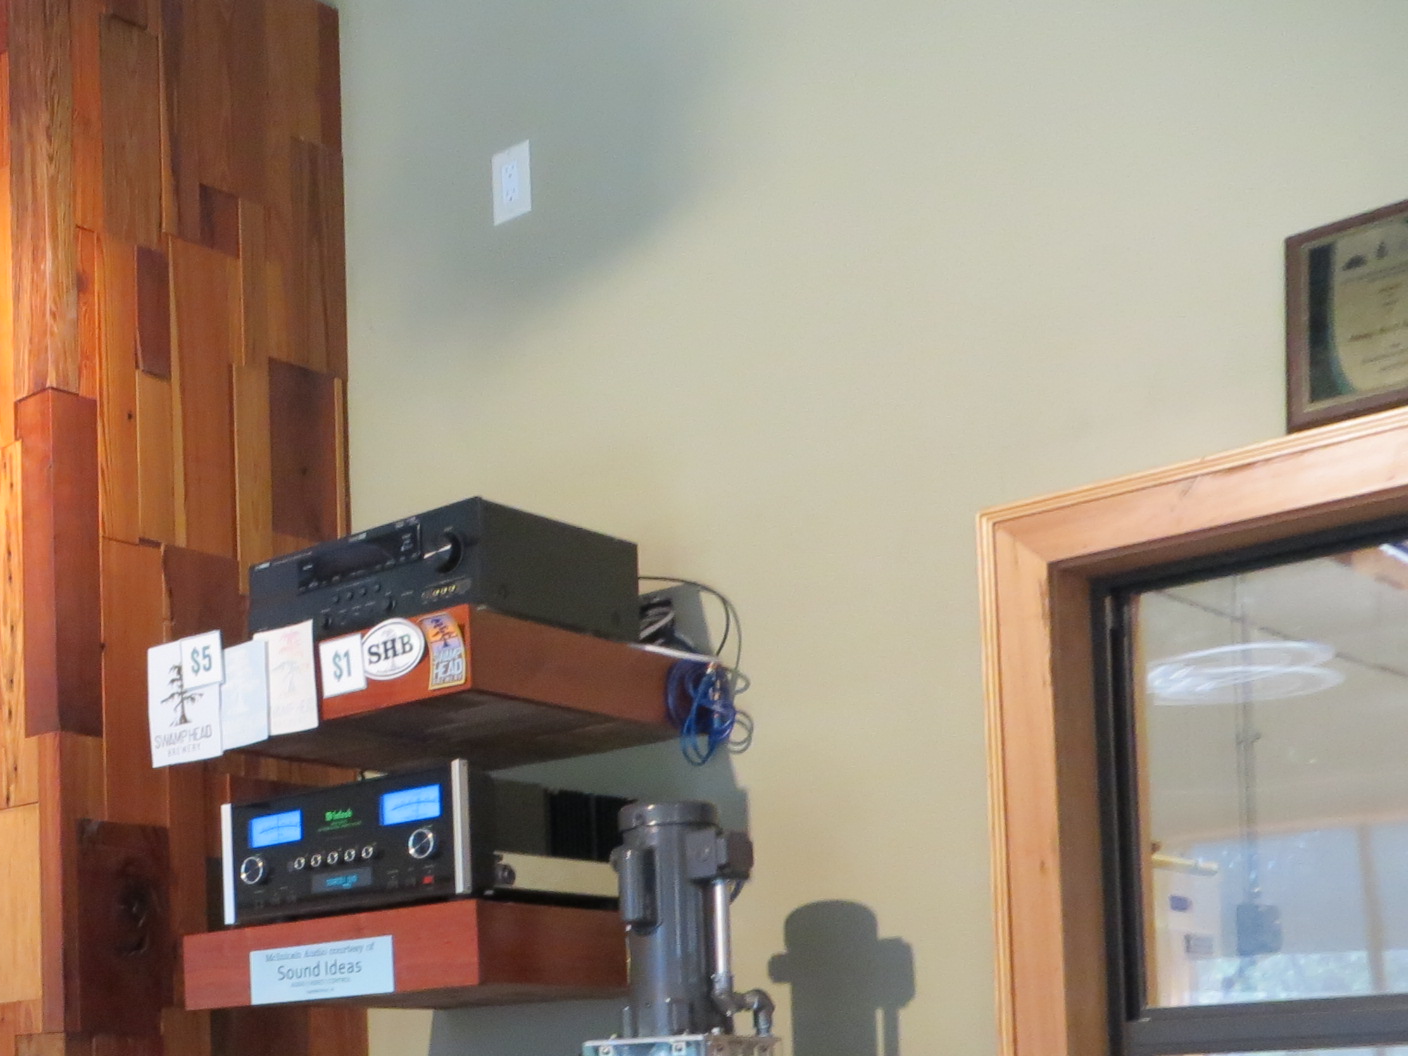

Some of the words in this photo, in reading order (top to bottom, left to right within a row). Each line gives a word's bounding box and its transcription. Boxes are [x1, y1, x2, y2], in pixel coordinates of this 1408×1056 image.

[191, 645, 213, 676] $5
[332, 649, 353, 681] $1
[367, 634, 413, 665] SHB
[277, 961, 321, 982] Sound
[325, 959, 362, 976] Ideas
